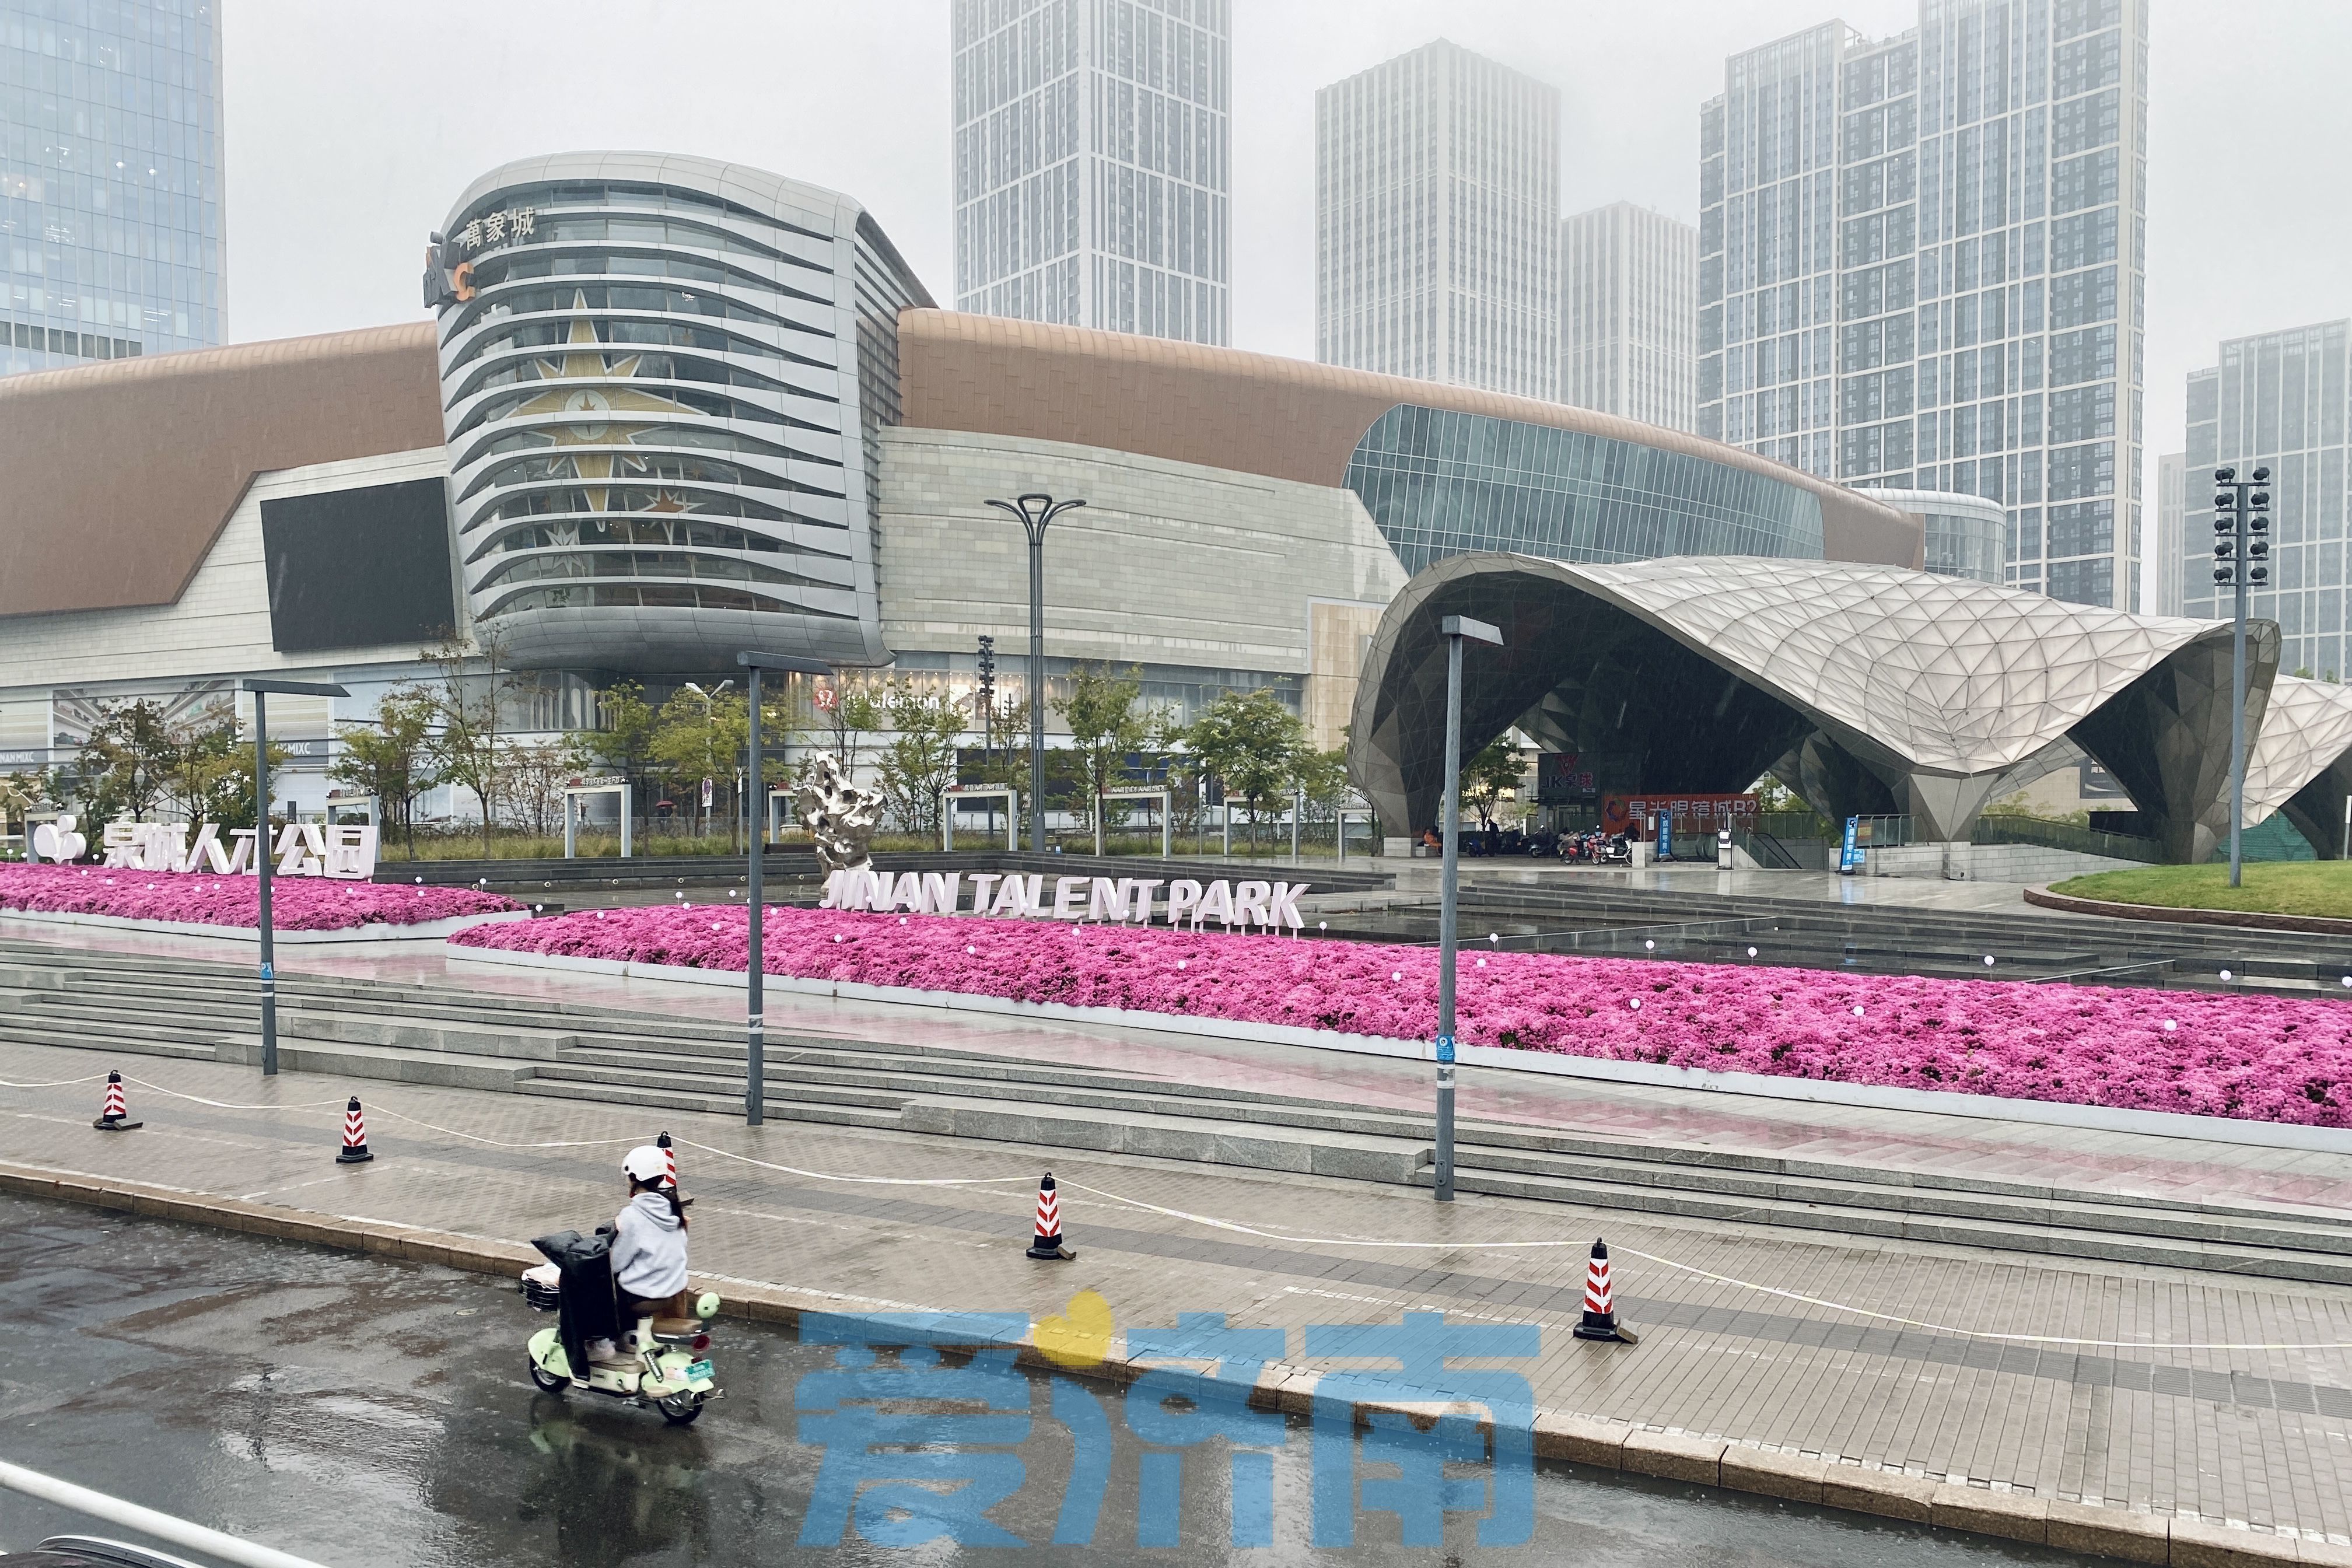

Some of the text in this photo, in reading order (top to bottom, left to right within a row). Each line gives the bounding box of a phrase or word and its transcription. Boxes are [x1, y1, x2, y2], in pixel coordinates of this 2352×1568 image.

[466, 206, 537, 251] 萬象城
[103, 814, 379, 880] 泉城人才公园
[818, 869, 1311, 929] JINAN TALENT PARK
